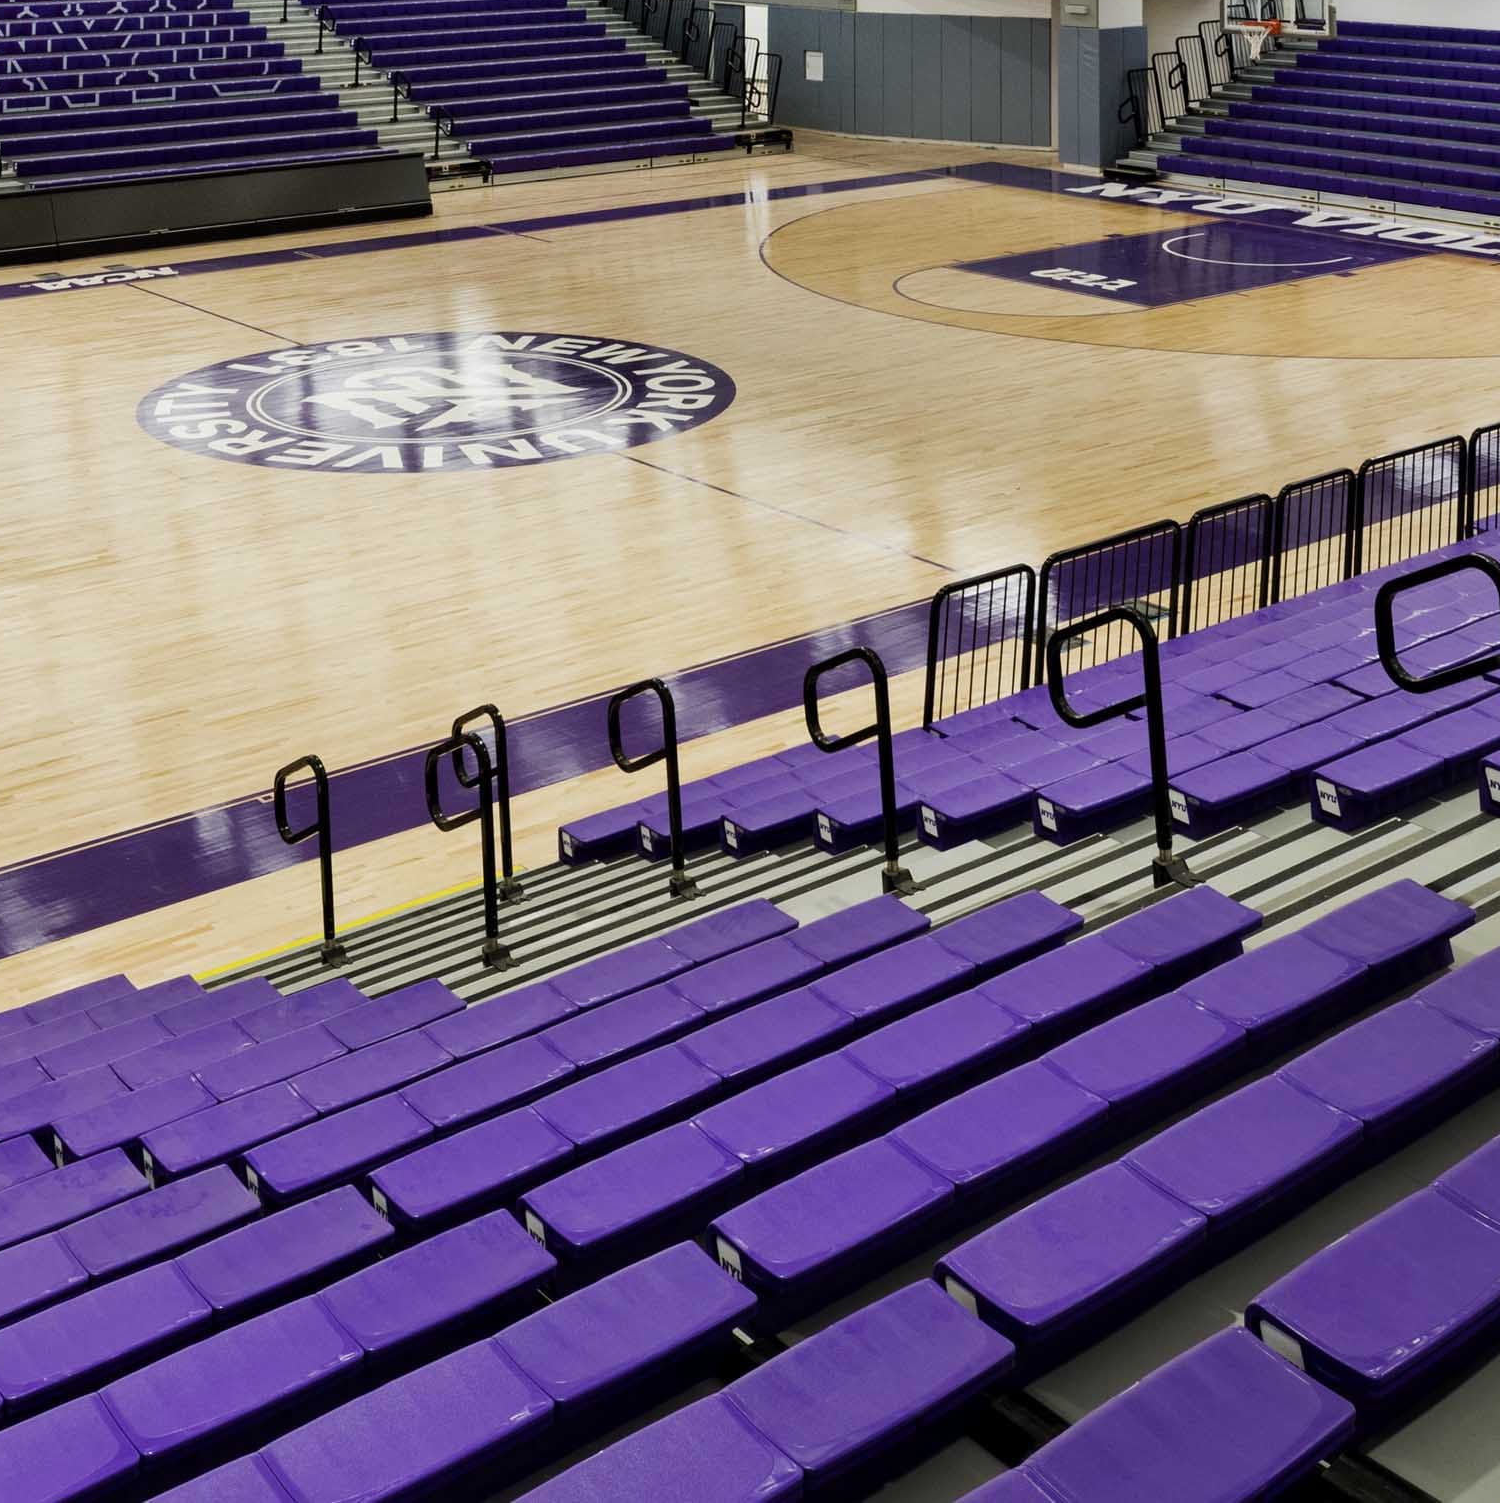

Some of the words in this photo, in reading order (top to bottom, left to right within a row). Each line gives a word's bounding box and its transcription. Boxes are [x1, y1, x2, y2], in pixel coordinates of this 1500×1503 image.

[1064, 182, 1297, 215] NYU
[30, 266, 180, 291] NCAA
[226, 336, 426, 374] 1831
[466, 334, 668, 365] NEW
[610, 359, 717, 432] YORK
[154, 381, 627, 469] UNIVERSITY
[1172, 800, 1188, 813] NYU
[1320, 790, 1338, 803] NYU
